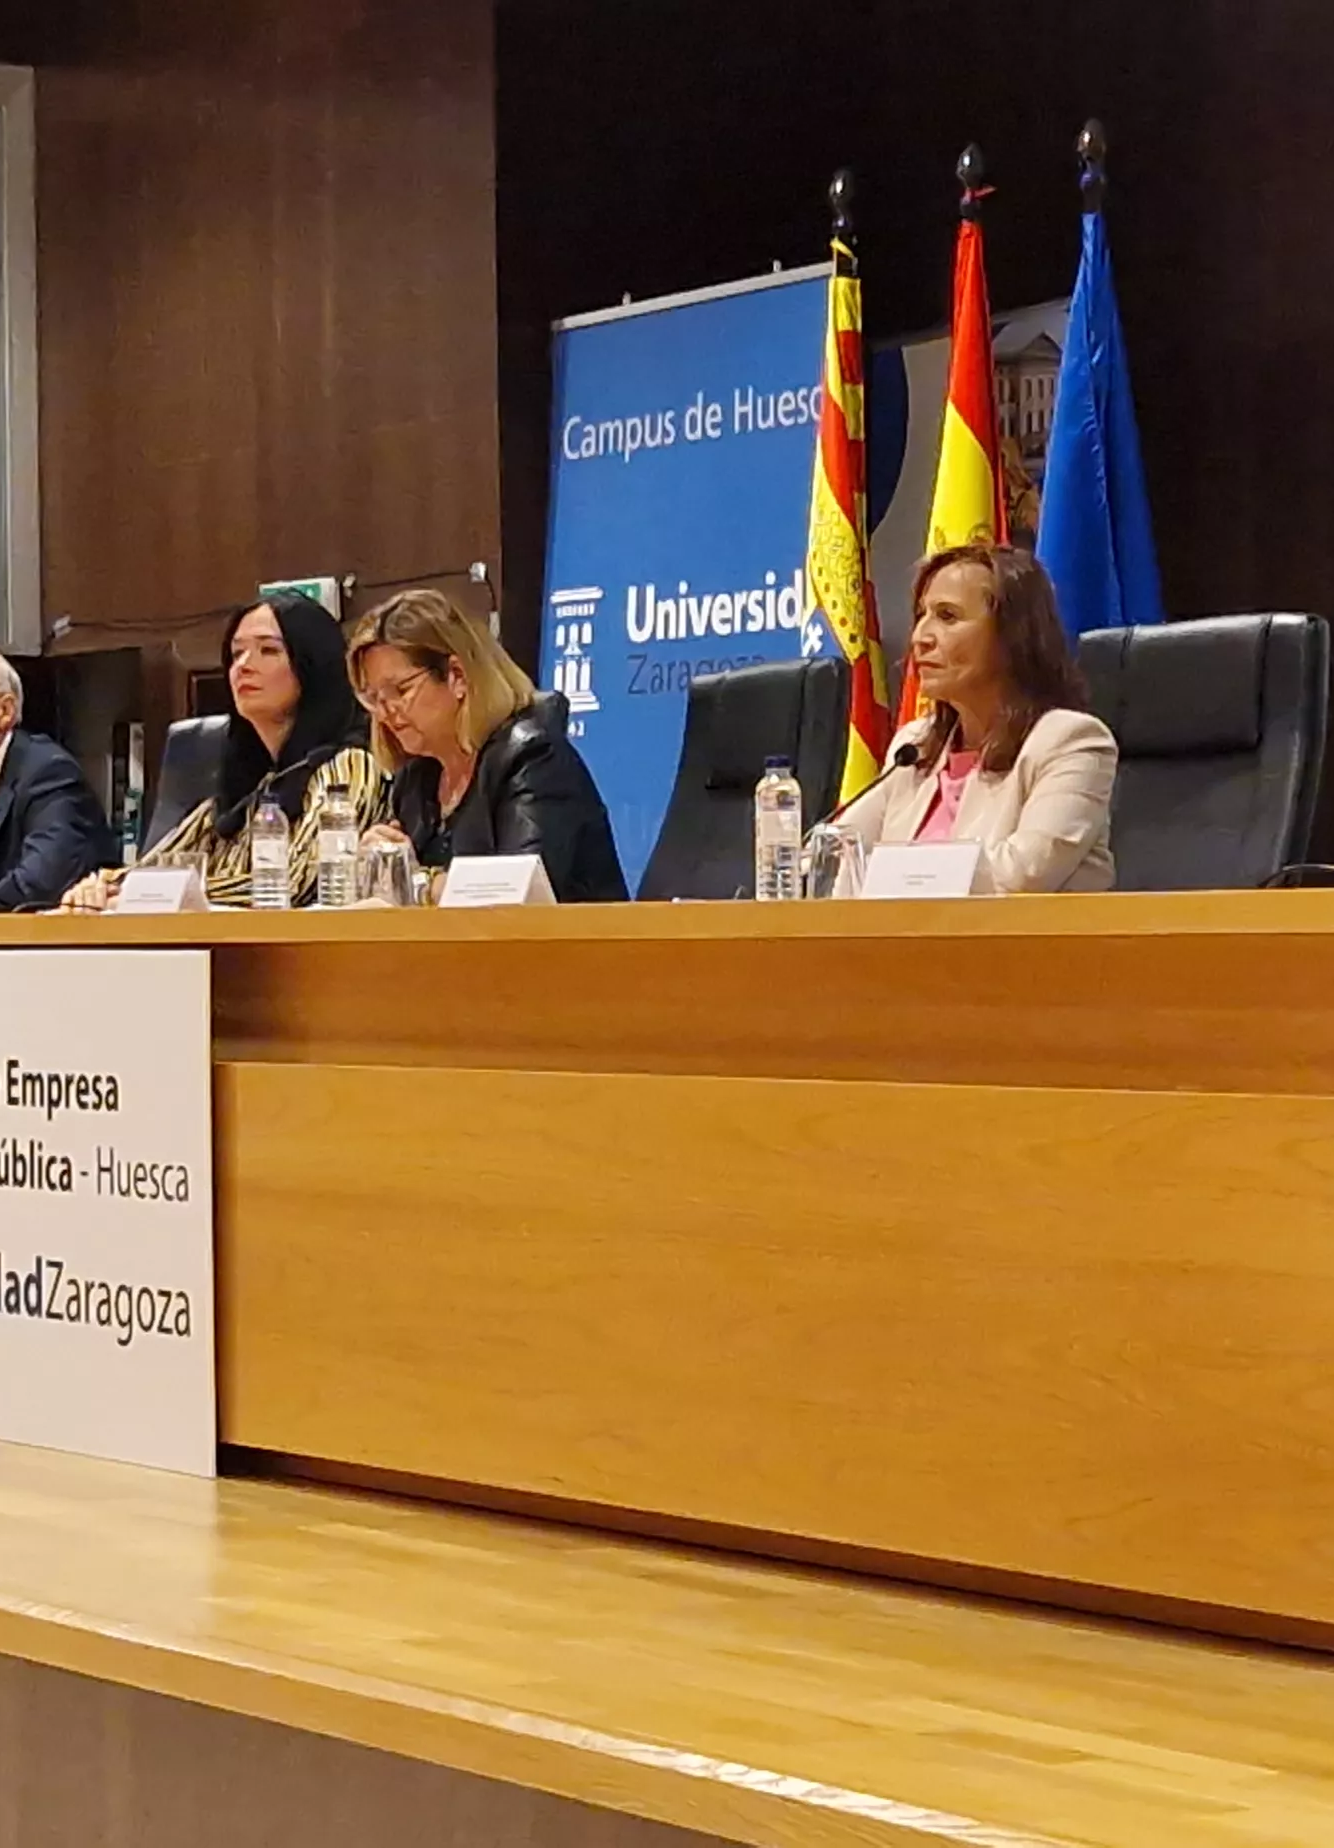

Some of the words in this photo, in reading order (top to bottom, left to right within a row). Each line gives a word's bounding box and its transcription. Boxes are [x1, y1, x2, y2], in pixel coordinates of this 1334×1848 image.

[563, 409, 676, 464] Campus
[684, 390, 723, 441] de
[733, 384, 824, 435] Huesc
[626, 568, 804, 644] Universid
[6, 1059, 120, 1121] Empresa
[96, 1146, 190, 1203] Huesca
